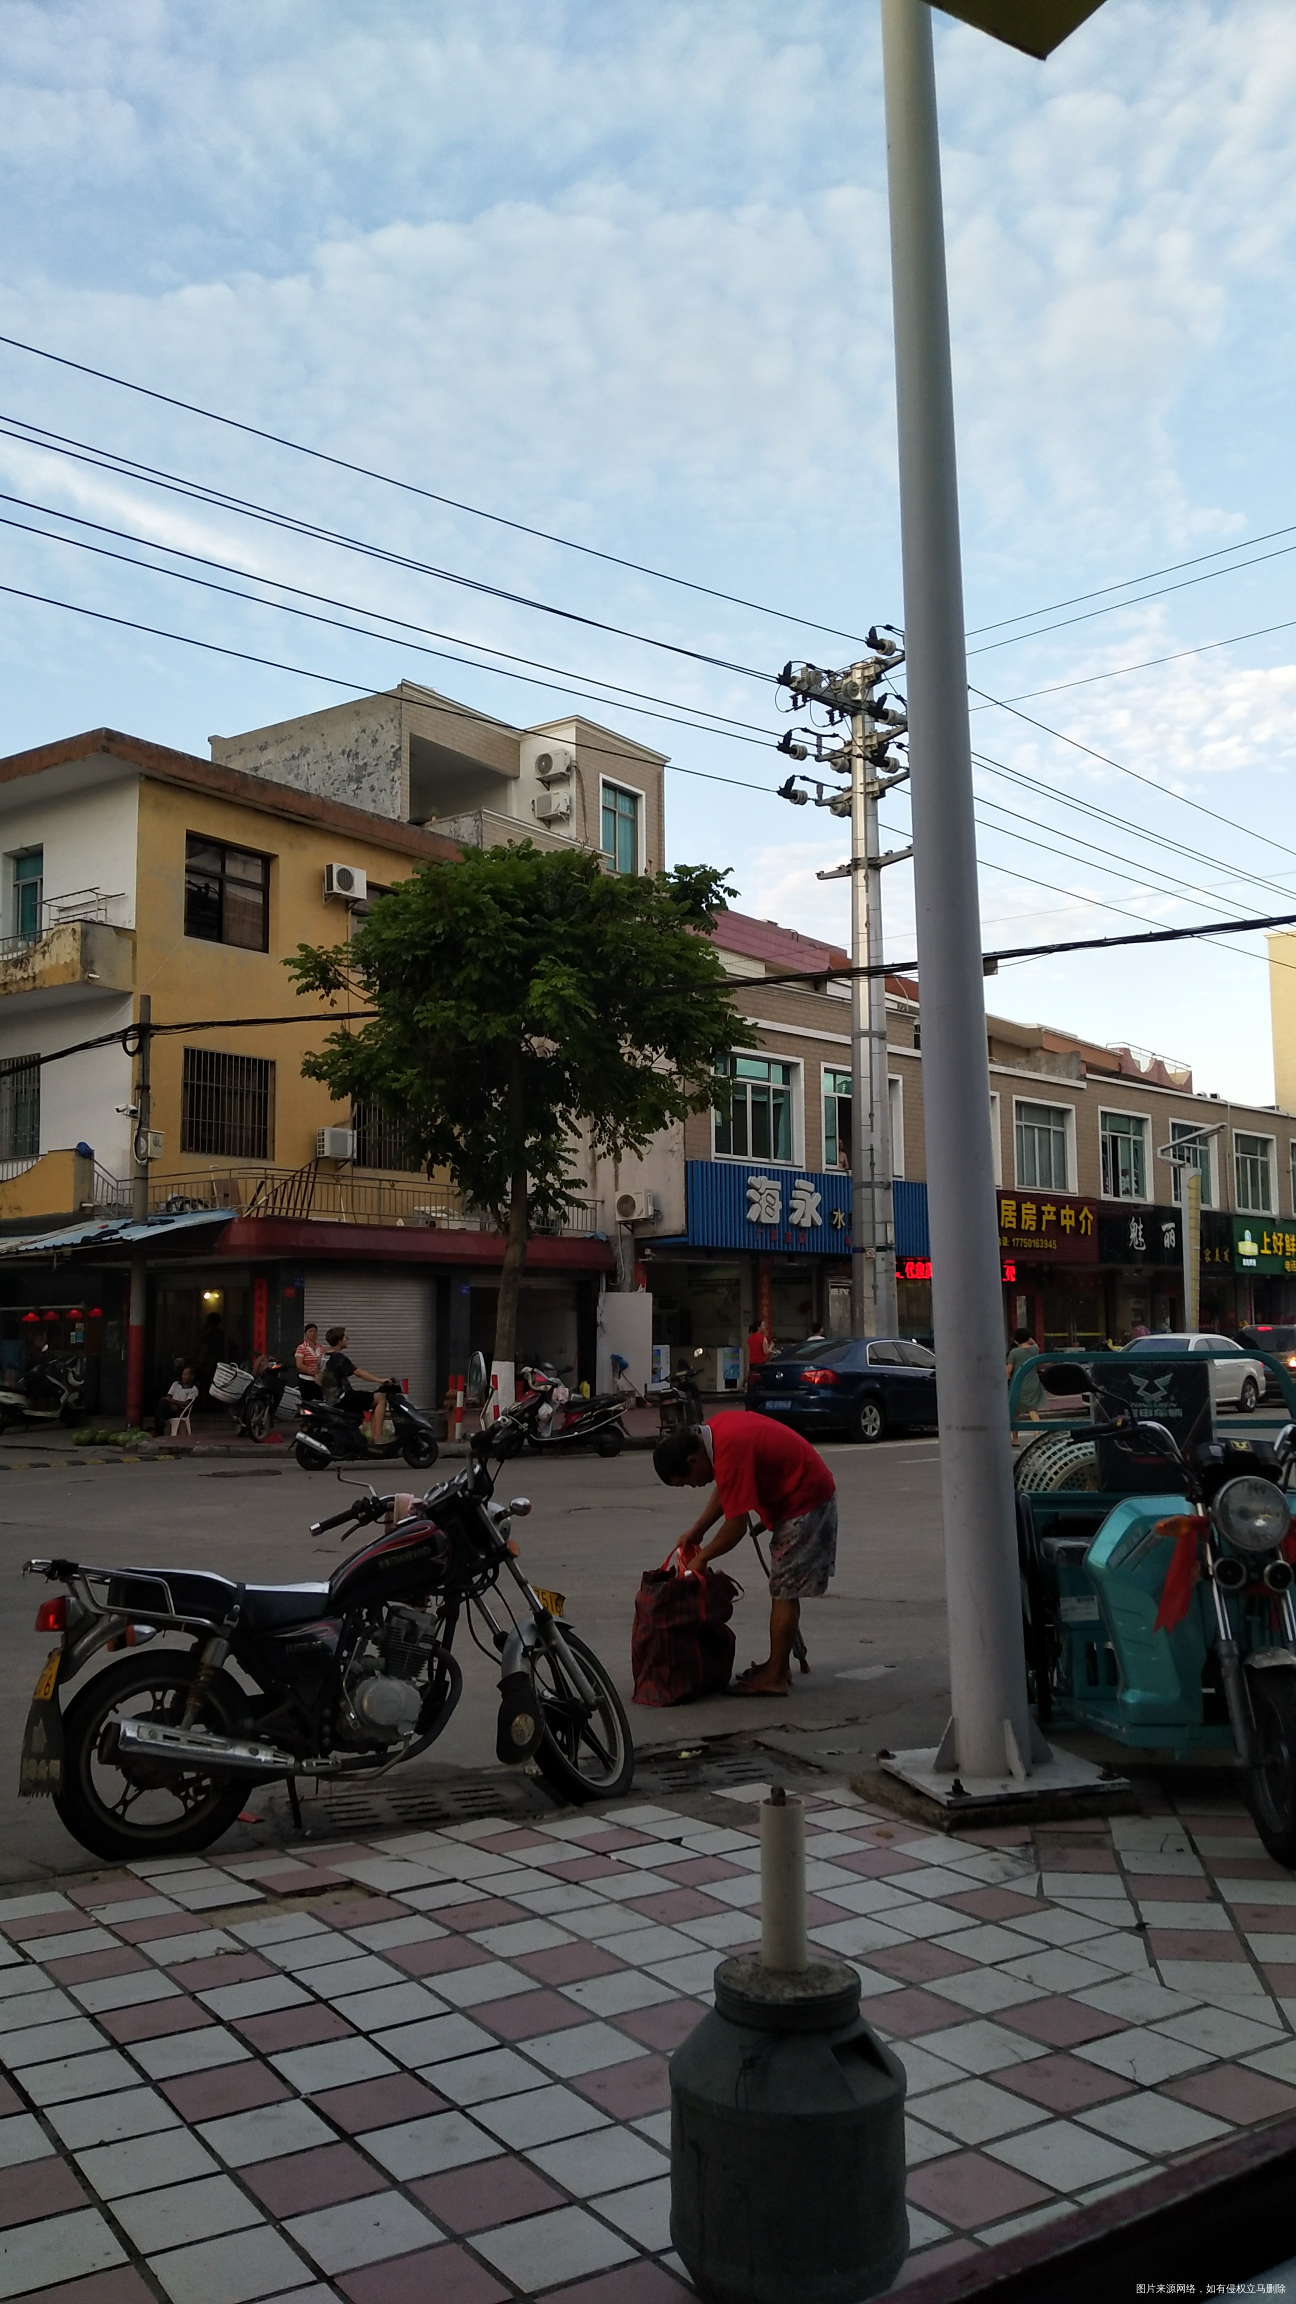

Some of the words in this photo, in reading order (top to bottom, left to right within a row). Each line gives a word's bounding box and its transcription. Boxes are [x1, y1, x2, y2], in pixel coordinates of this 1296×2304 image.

[746, 1175, 823, 1228] 海永
[1000, 1198, 1095, 1236] 居房产中介
[1011, 1237, 1058, 1250] 17750163945
